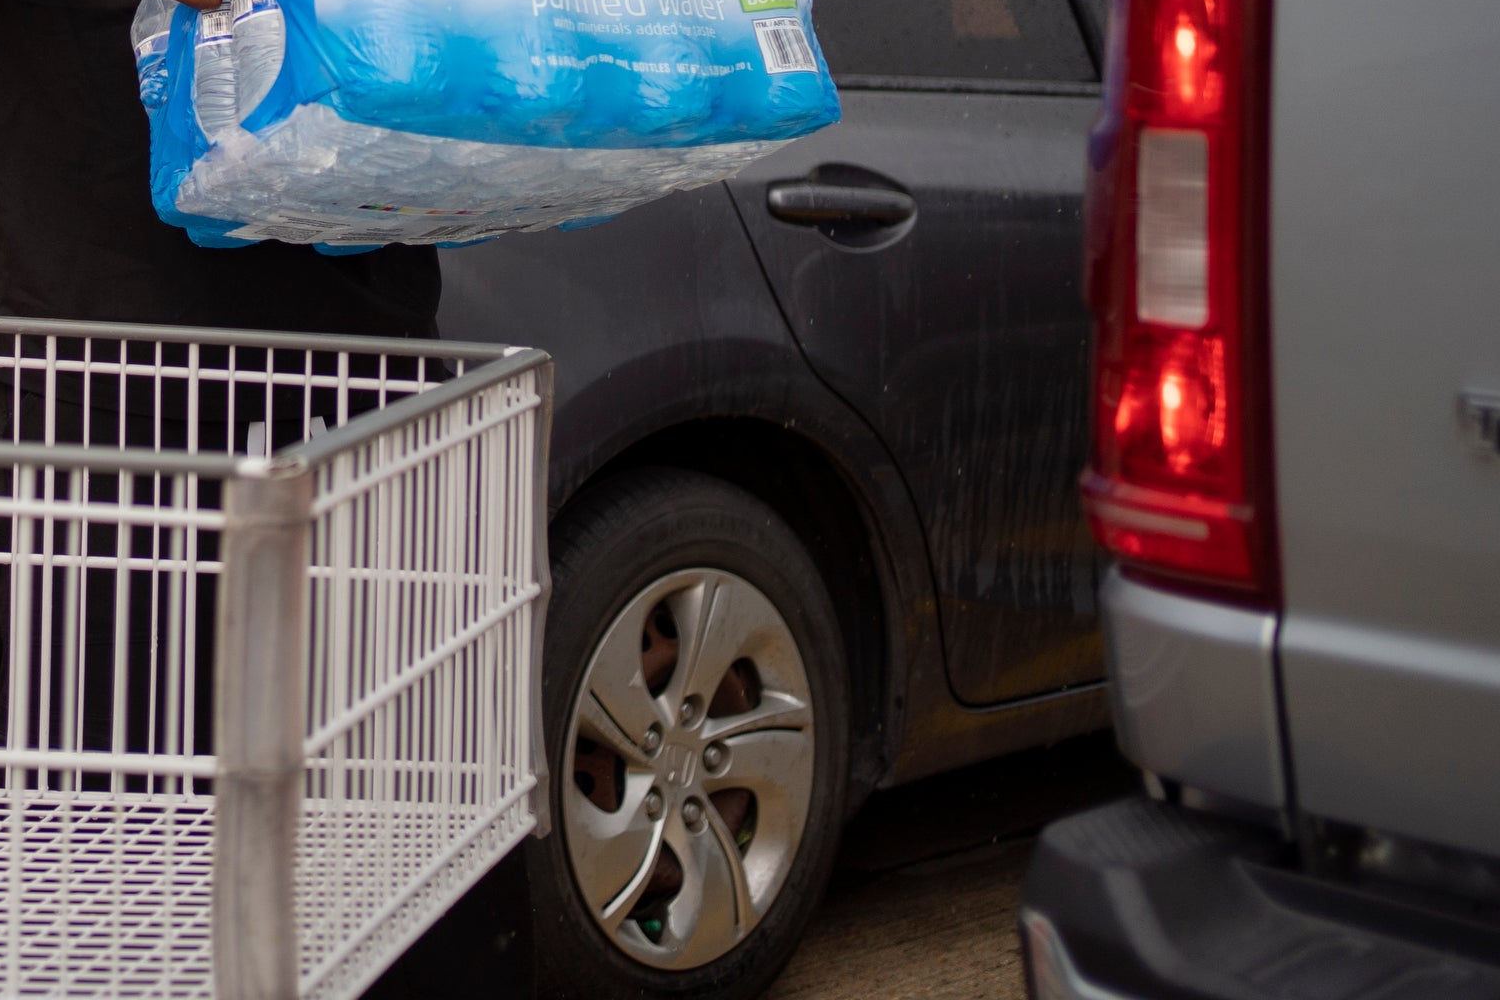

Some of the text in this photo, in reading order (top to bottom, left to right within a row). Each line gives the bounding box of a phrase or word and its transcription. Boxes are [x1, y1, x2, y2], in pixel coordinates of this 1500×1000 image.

[577, 21, 632, 36] minerals
[636, 22, 678, 36] added
[632, 62, 671, 72] BOTTLES
